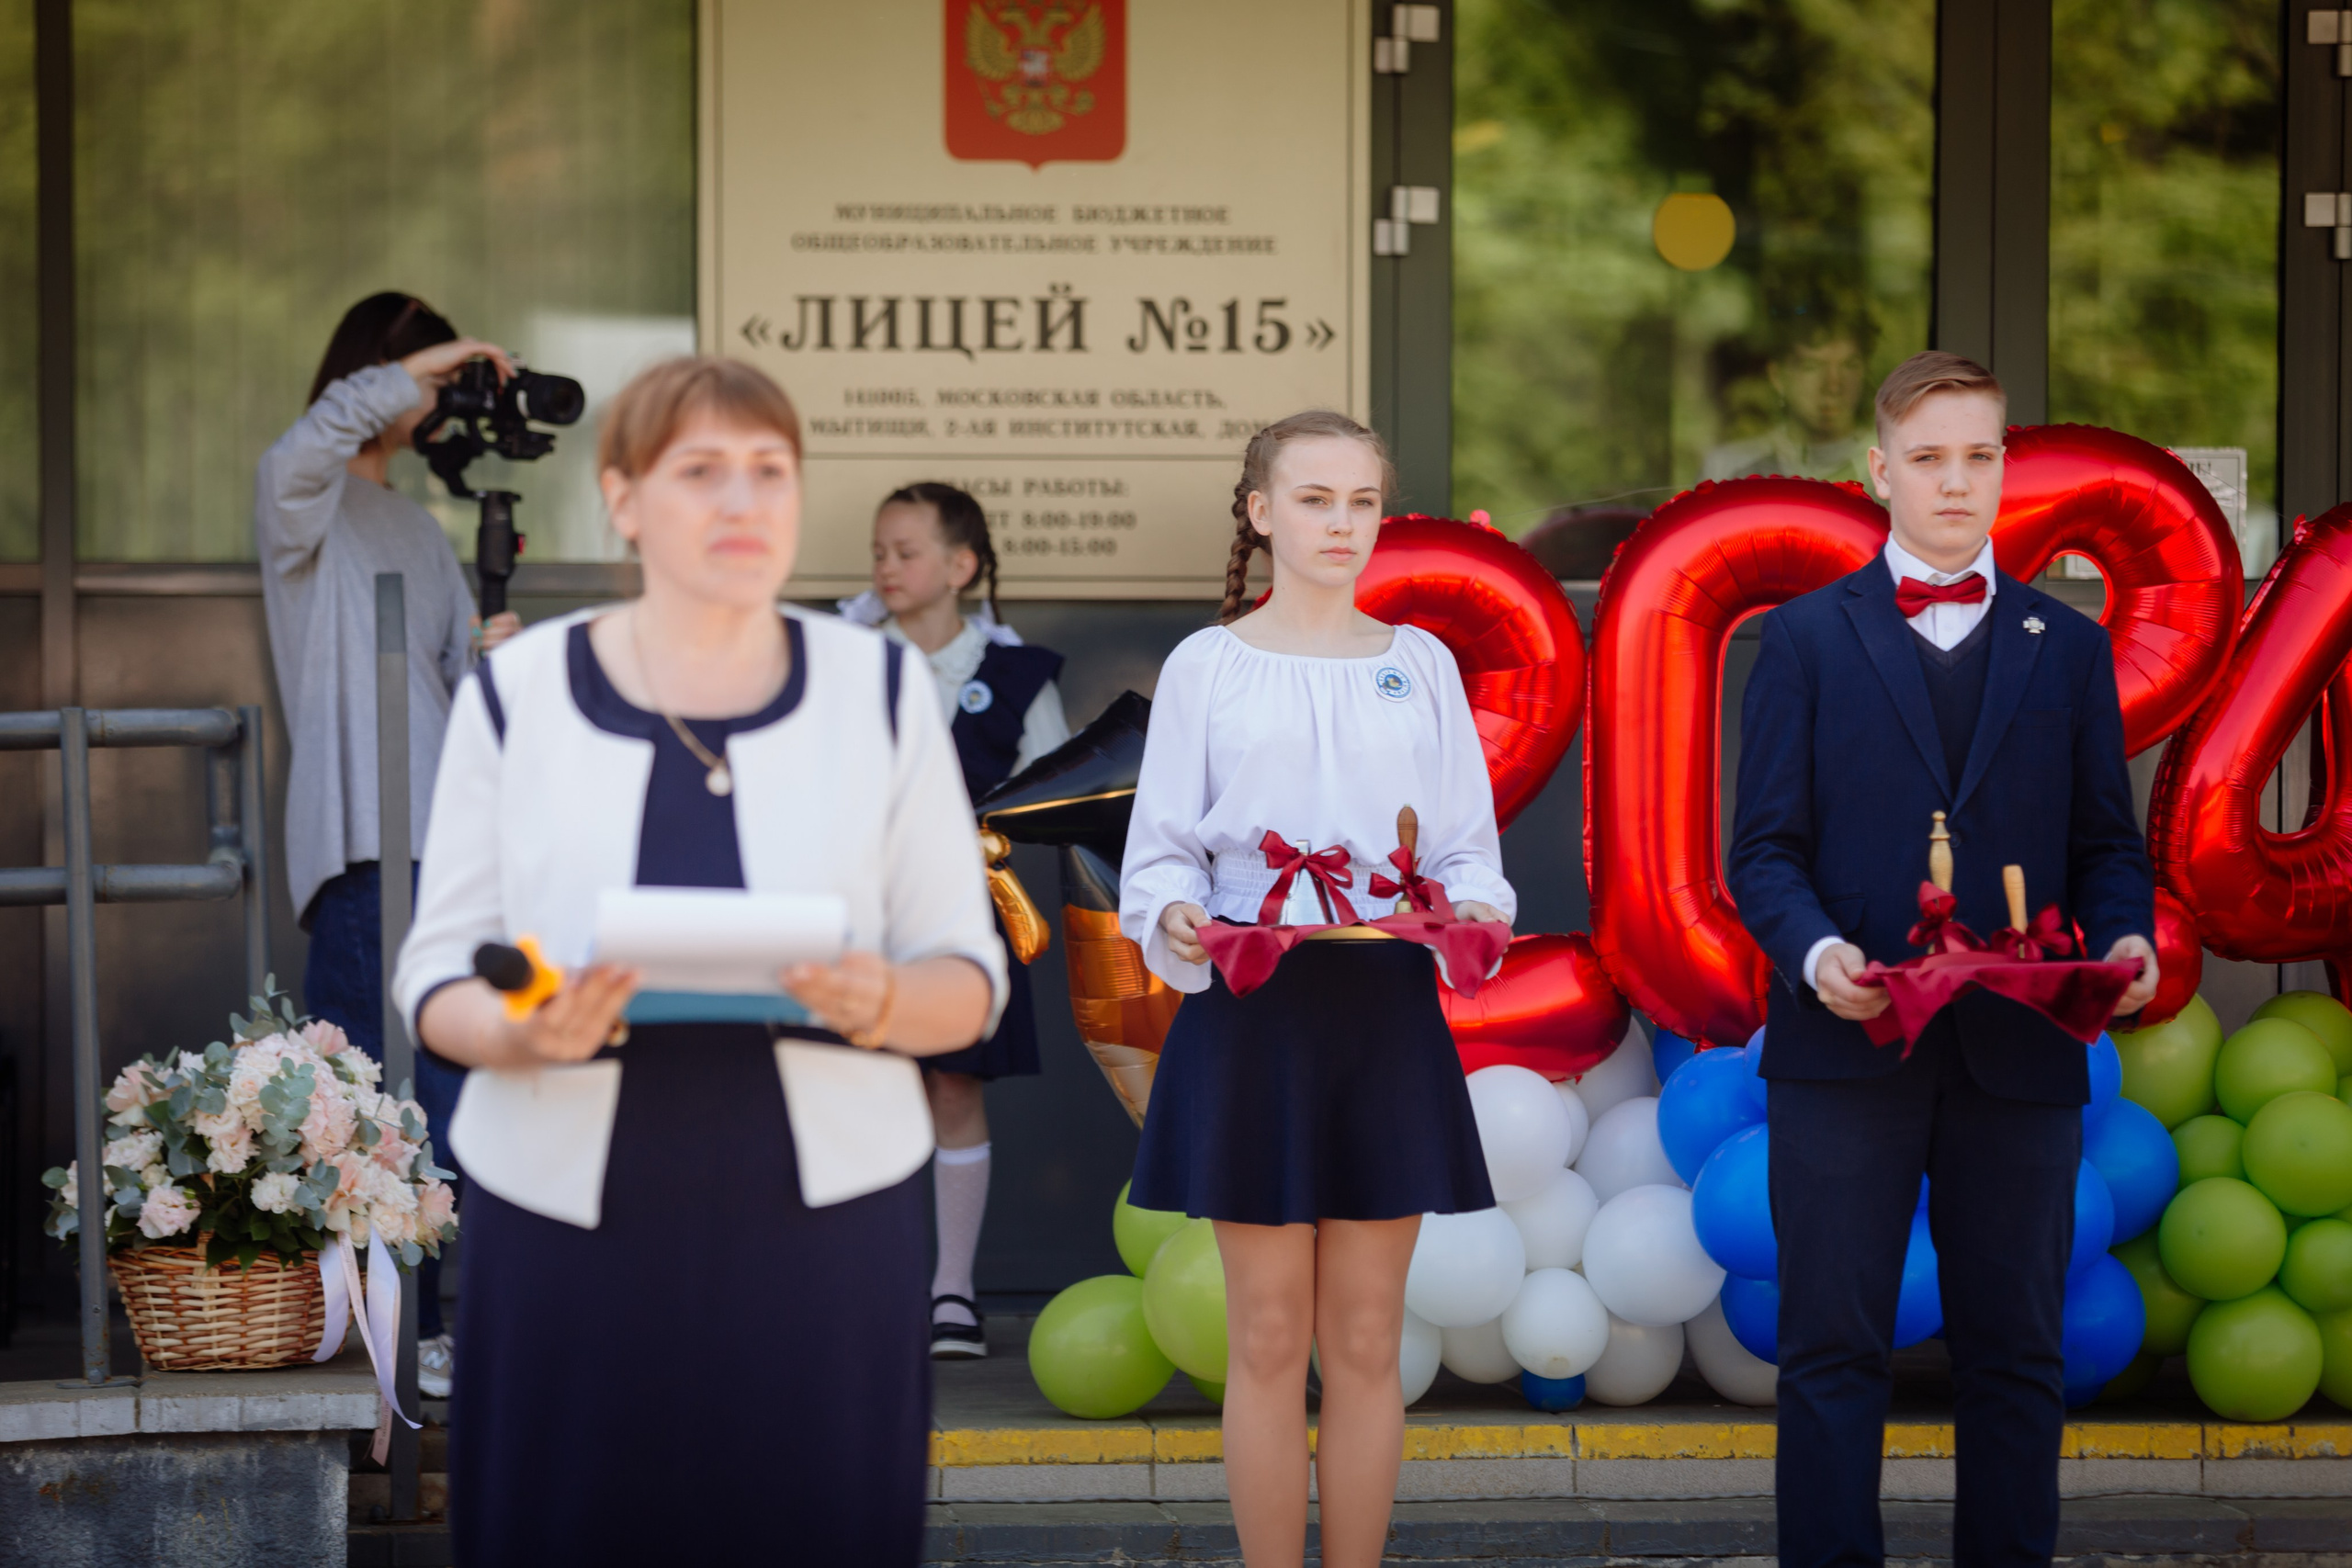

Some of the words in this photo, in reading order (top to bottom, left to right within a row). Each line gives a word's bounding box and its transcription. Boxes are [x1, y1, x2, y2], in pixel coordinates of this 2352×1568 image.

[834, 203, 1057, 224] МУНИЦИПАЛЬНОЕ
[1071, 205, 1229, 225] БЮДЖЕТНОЕ
[789, 232, 1096, 254] ОБЩЕОБРАЗОВАТЕЛЬНОЕ
[1109, 235, 1276, 254] УЧРЕЖДЕНИЕ
[741, 283, 1090, 361] «ЛИЦЕЙ
[1125, 295, 1336, 355] №15»
[936, 389, 1100, 408] МОСКОВСКАЯ
[945, 418, 998, 438] 2-АЯ
[944, 477, 1012, 497] АСЫ
[1023, 477, 1130, 498] РАБОТЫ:
